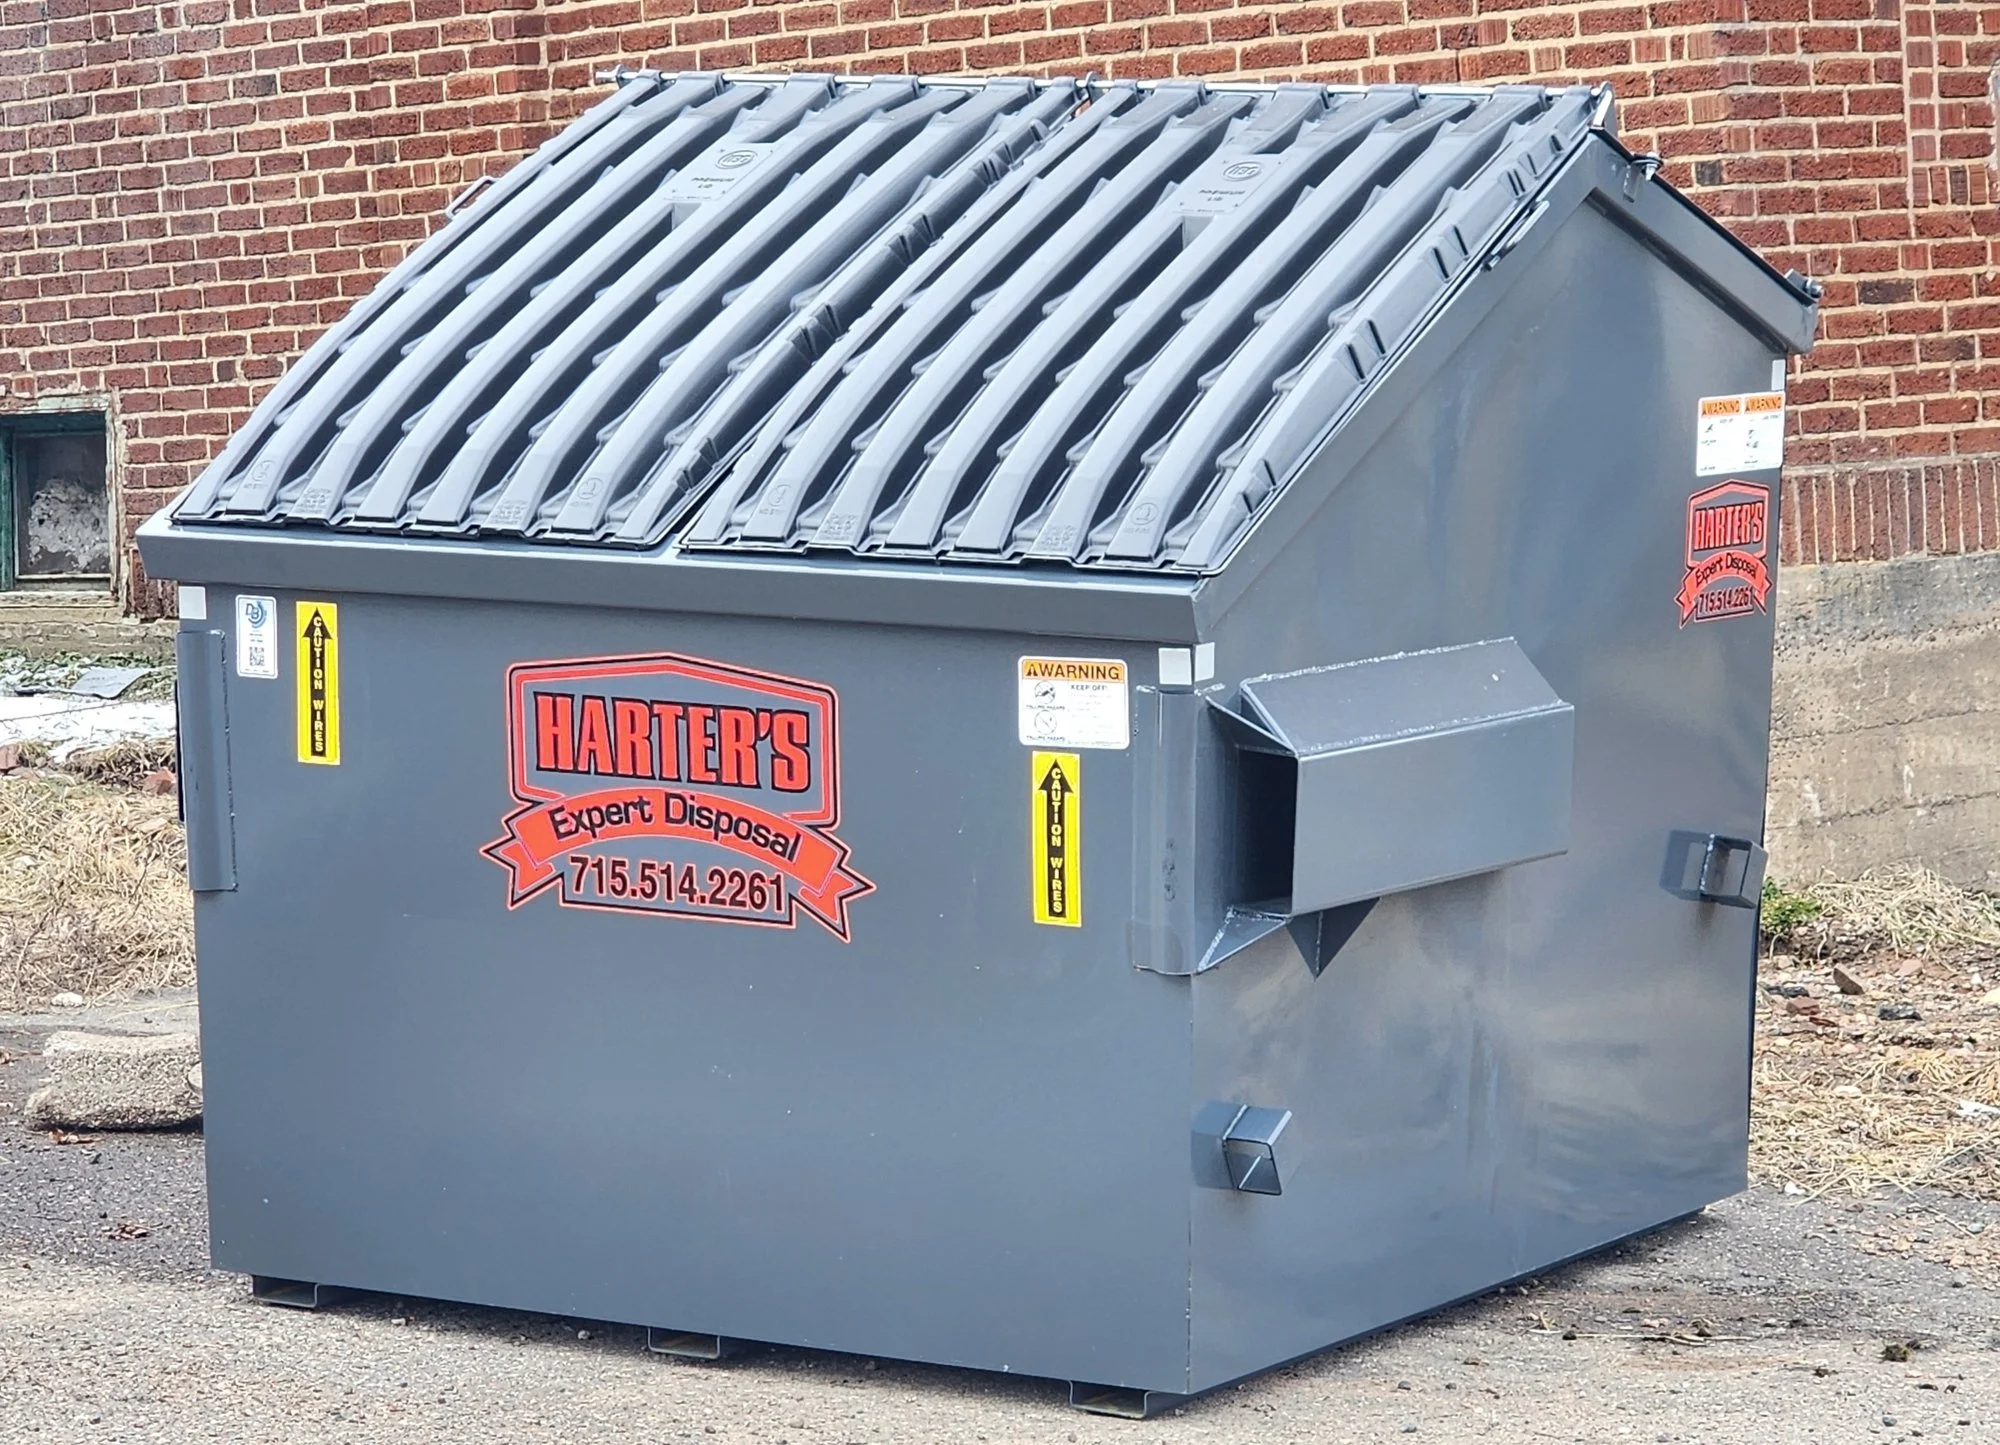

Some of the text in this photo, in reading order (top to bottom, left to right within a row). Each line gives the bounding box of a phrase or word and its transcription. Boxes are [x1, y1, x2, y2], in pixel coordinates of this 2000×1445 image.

[1694, 501, 1764, 551] HARTER'S
[1695, 553, 1758, 587] Expert Disposal
[1699, 585, 1754, 613] 715.514.2261
[313, 616, 324, 752] CAUTION WIRES
[1039, 663, 1120, 680] WARNING
[534, 692, 811, 792] HARTER'S
[549, 792, 802, 862] Expert Disposal
[1050, 767, 1063, 913] CAUTION WIRES
[570, 856, 786, 912] 715.514.2261
